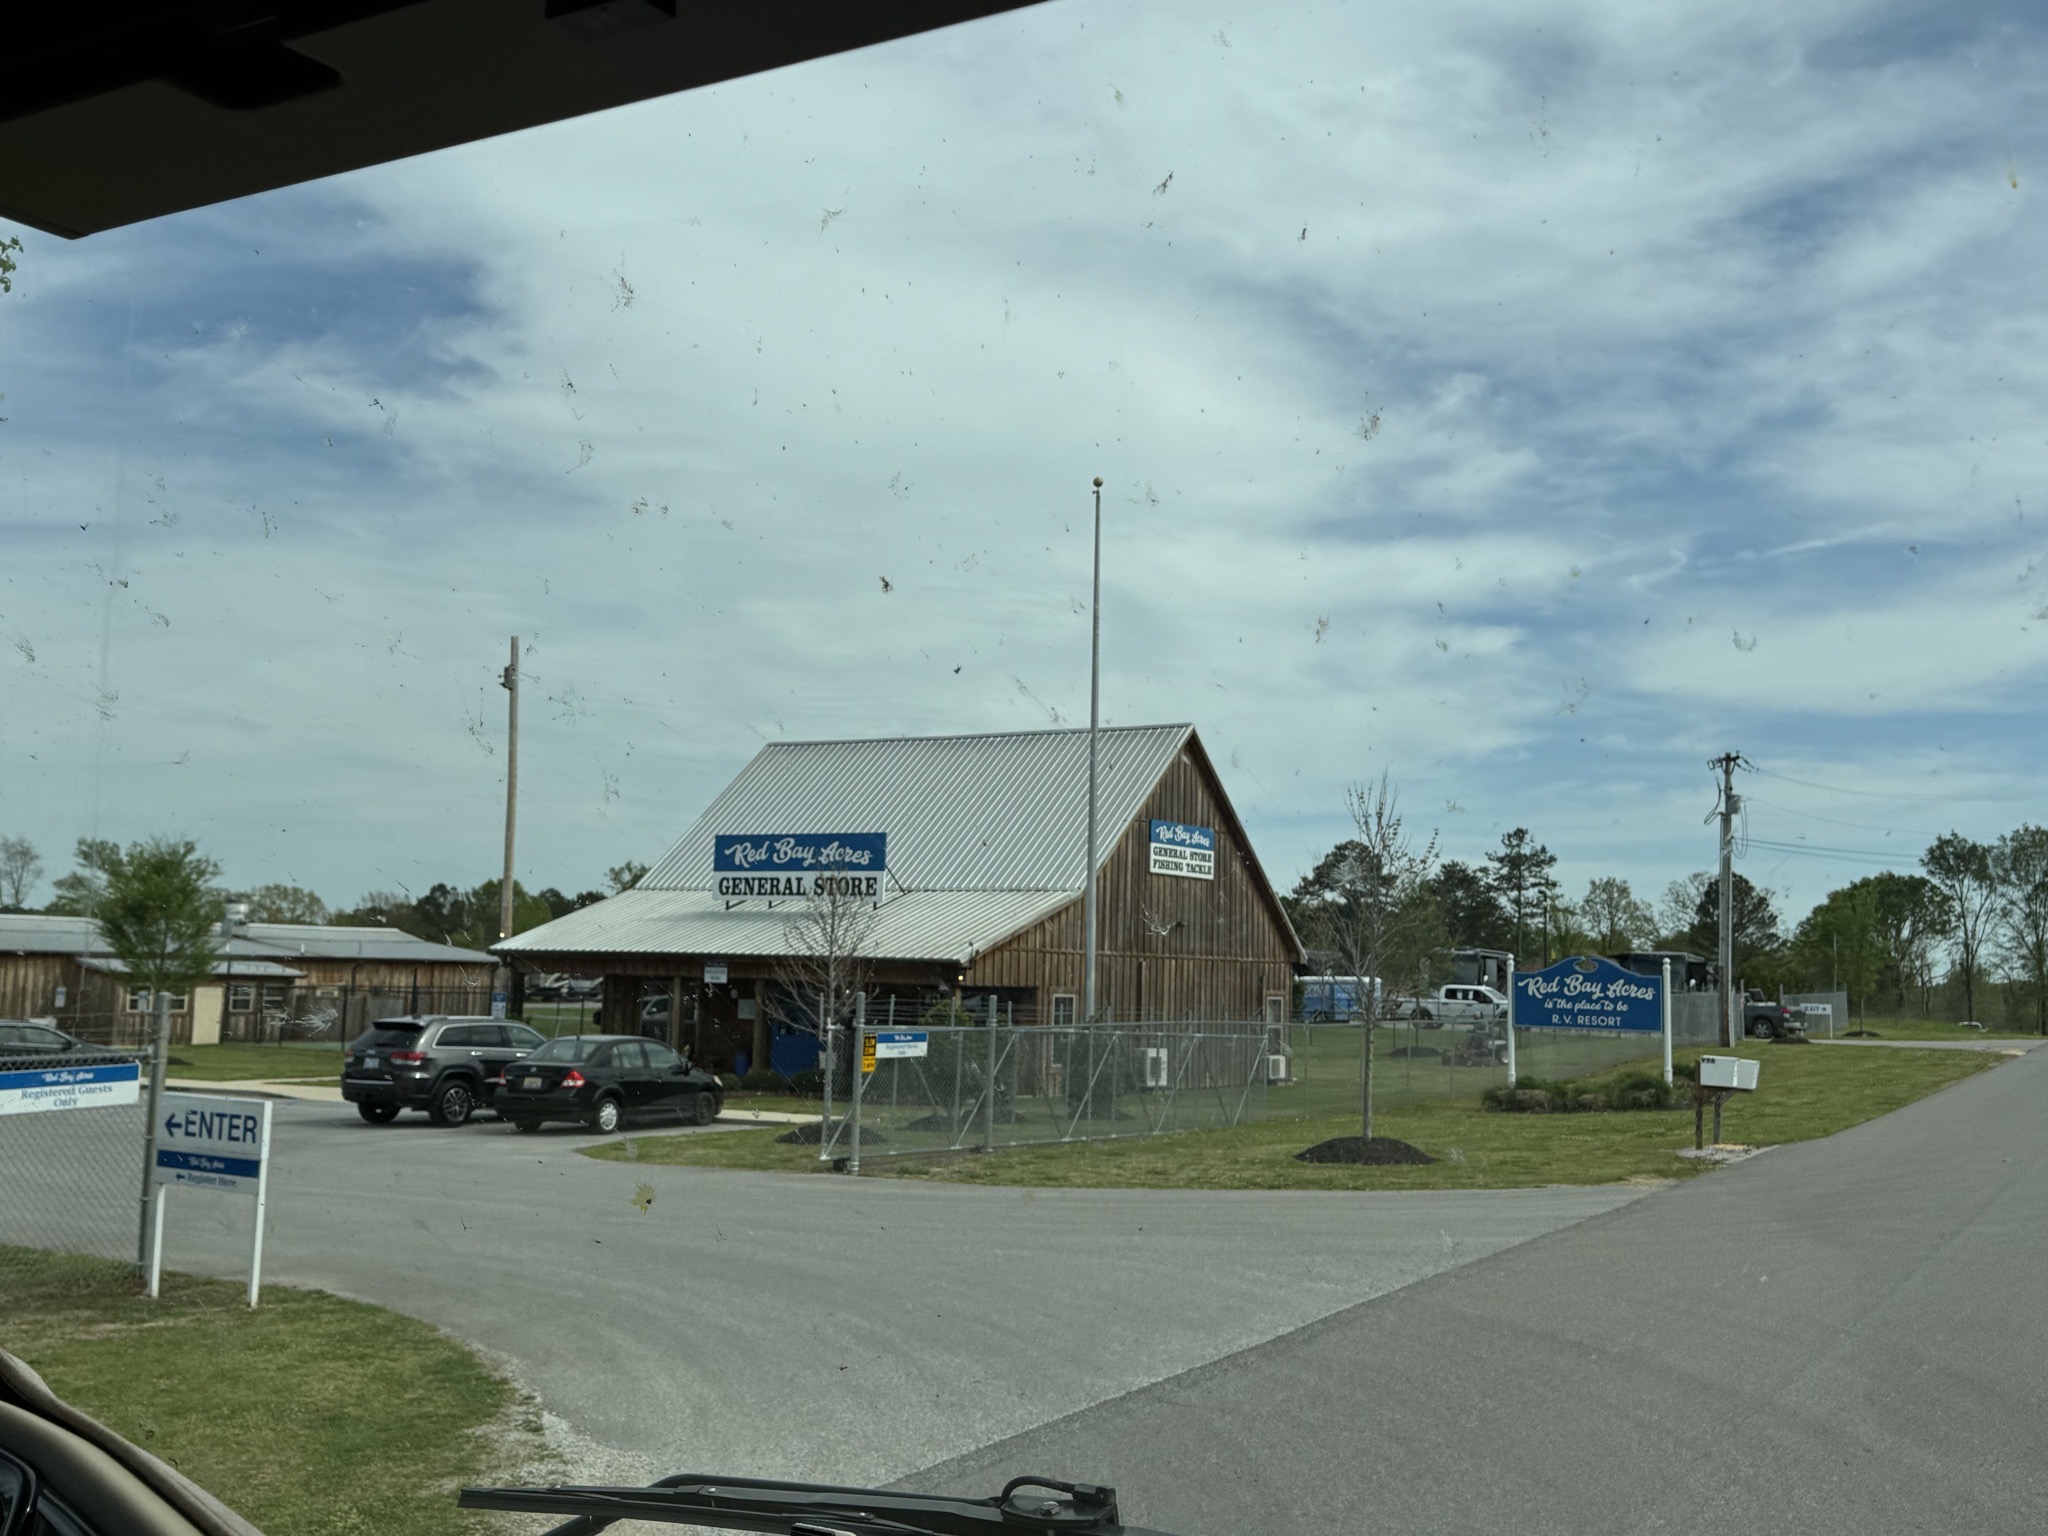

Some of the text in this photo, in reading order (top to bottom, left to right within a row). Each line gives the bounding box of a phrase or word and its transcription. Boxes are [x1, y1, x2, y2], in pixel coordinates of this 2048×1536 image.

[1156, 825, 1210, 848] Red Bay Acres
[724, 837, 873, 868] Red Bay Acres
[1153, 846, 1212, 863] GENERAL STORE
[1153, 858, 1212, 876] FISHING TACKLE
[718, 876, 877, 896] GENERAL STORE
[1517, 974, 1657, 1000] Red Bay Acres
[1544, 997, 1629, 1013] is the place to be
[1552, 1014, 1622, 1027] R. V. RESORT
[21, 1084, 113, 1101] Registered Guests
[53, 1096, 77, 1109] Only
[184, 1110, 258, 1144] ENTER
